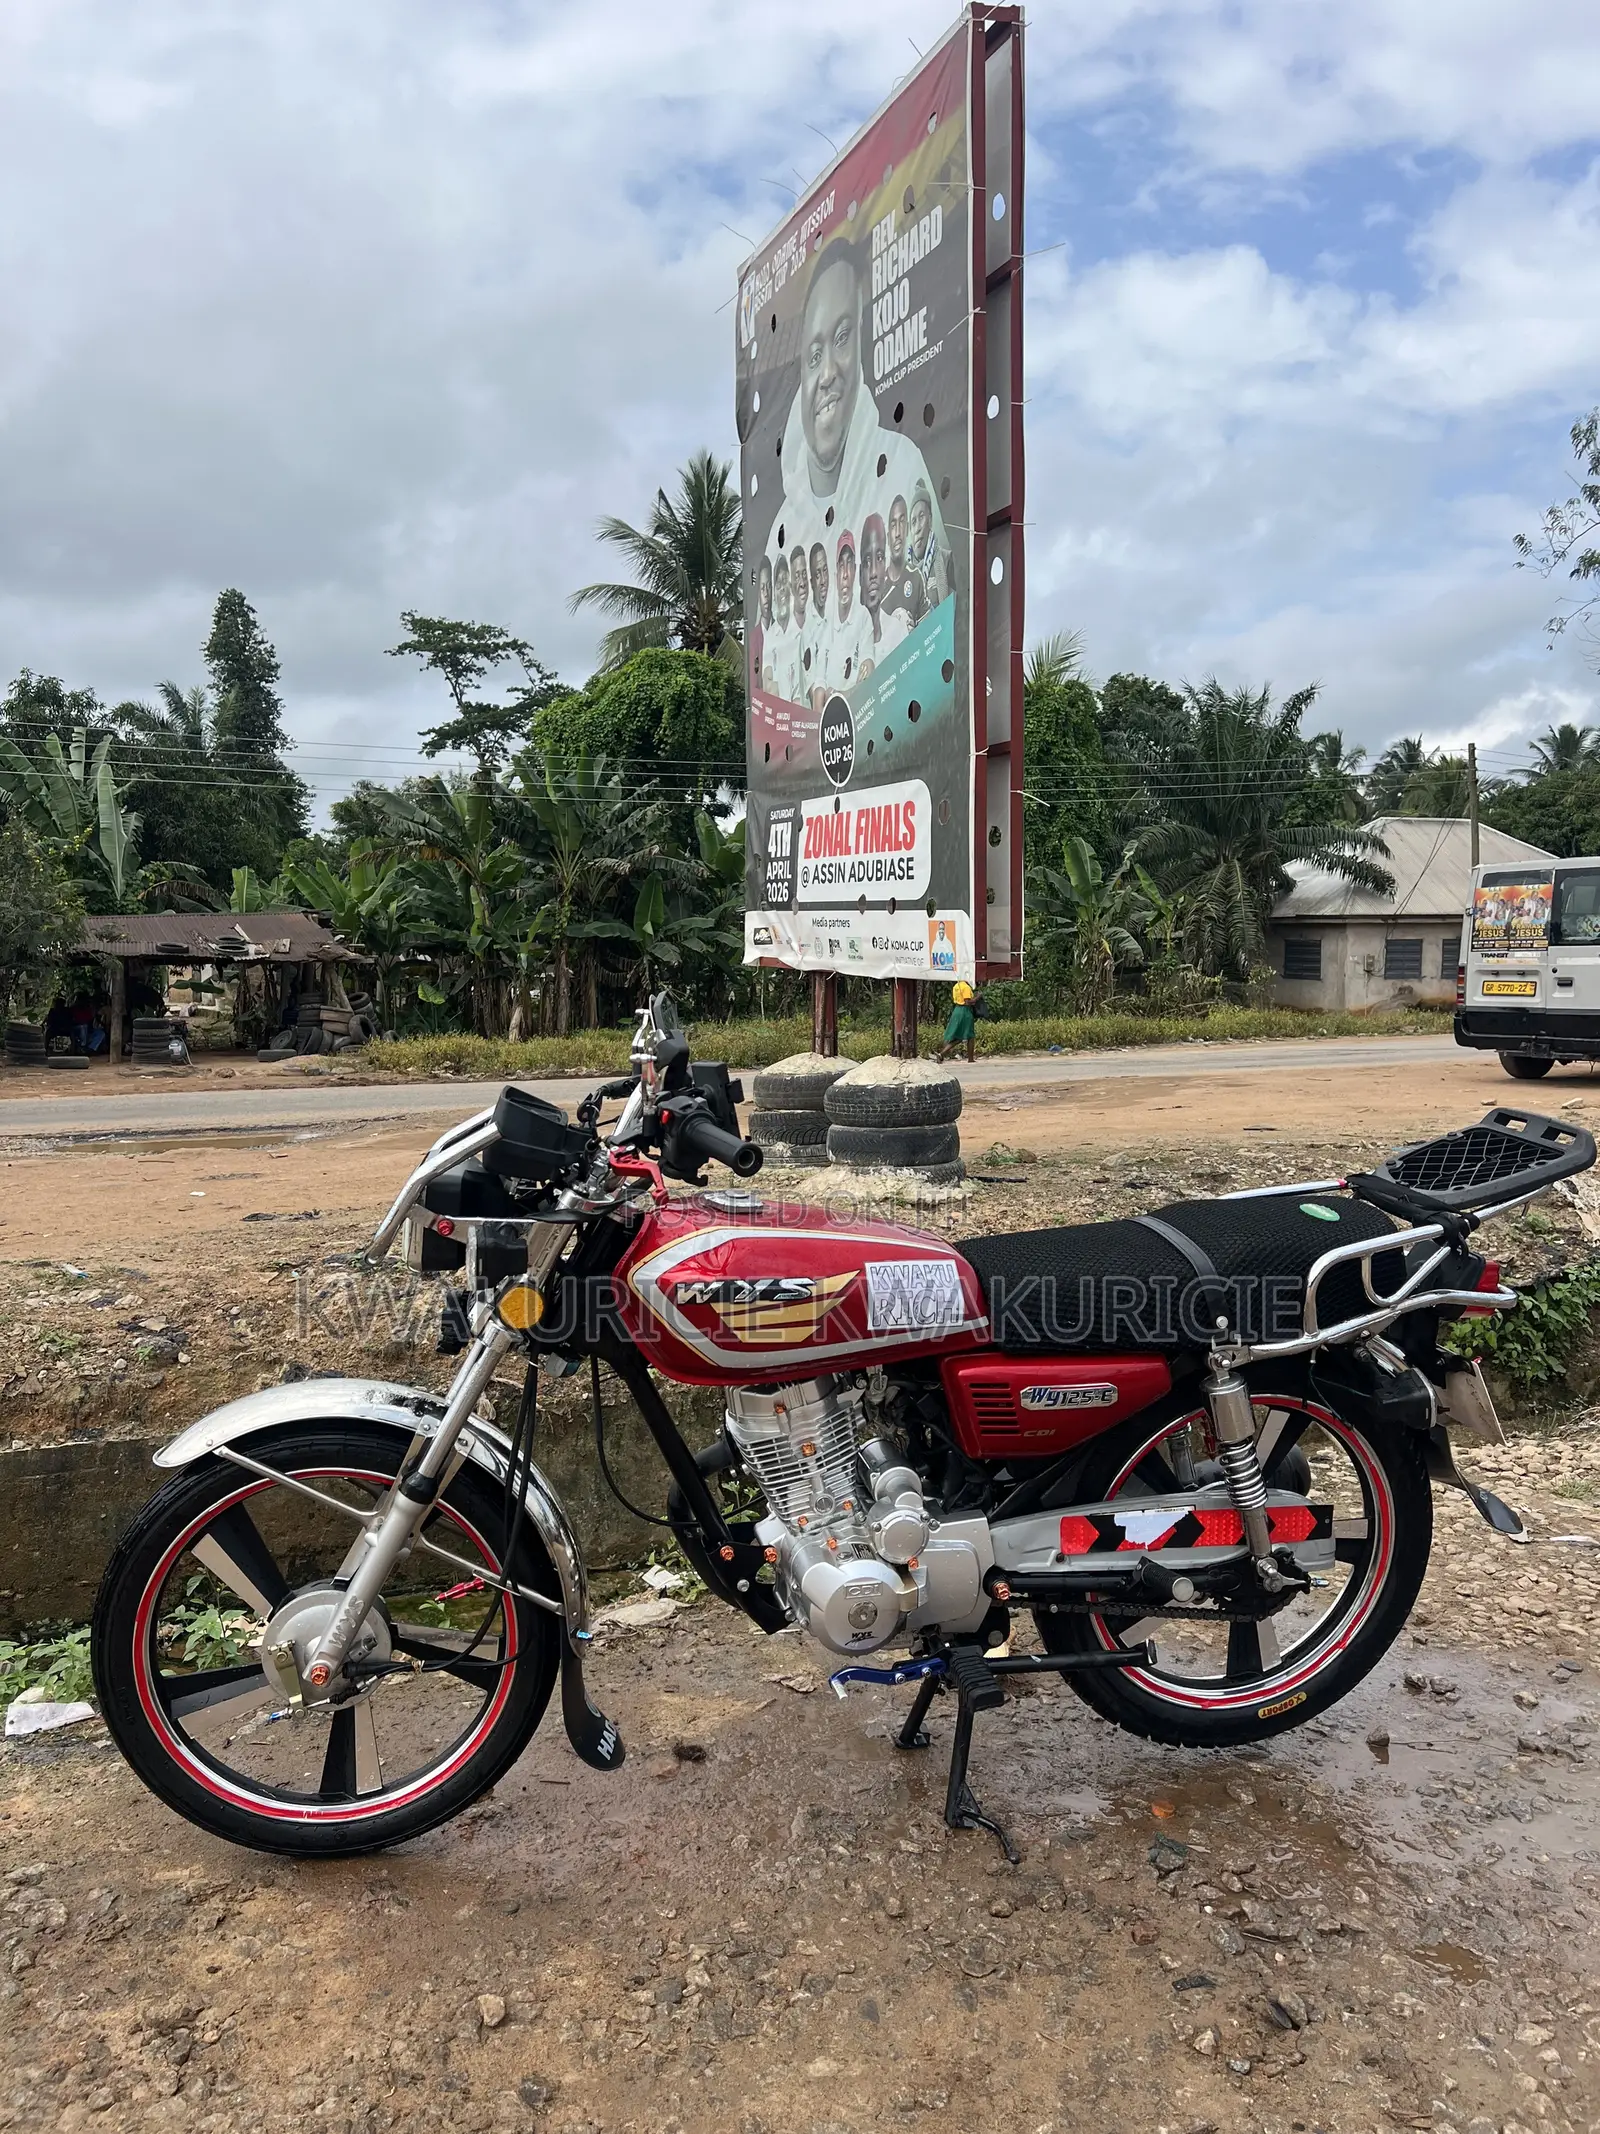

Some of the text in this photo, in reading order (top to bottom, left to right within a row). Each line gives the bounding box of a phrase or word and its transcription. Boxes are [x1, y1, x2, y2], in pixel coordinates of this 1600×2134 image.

[872, 209, 897, 259] REV.
[872, 205, 943, 299] RICHARD
[872, 277, 910, 341] KOJO
[872, 306, 928, 381] ODAME
[874, 340, 944, 396] KOMA CUP PRESIDENT
[824, 722, 850, 743] KOMA
[823, 744, 853, 766] CUP 26
[770, 808, 795, 820] SATURDAY
[767, 822, 792, 858] 4TH
[804, 800, 916, 859] ZONAL FINALS
[766, 860, 792, 880] APRIL
[801, 857, 915, 888] @ ASSIN ADUBIASE
[766, 881, 789, 902] 2026
[812, 917, 851, 931] Media partners
[1479, 929, 1505, 937] JESUS
[1515, 928, 1544, 937] JESUS
[891, 940, 924, 951] KOMA CUP
[870, 1264, 955, 1290] KWAKU
[676, 1277, 817, 1305] WYS
[872, 1289, 960, 1327] RICH
[1023, 1428, 1056, 1437] CDI
